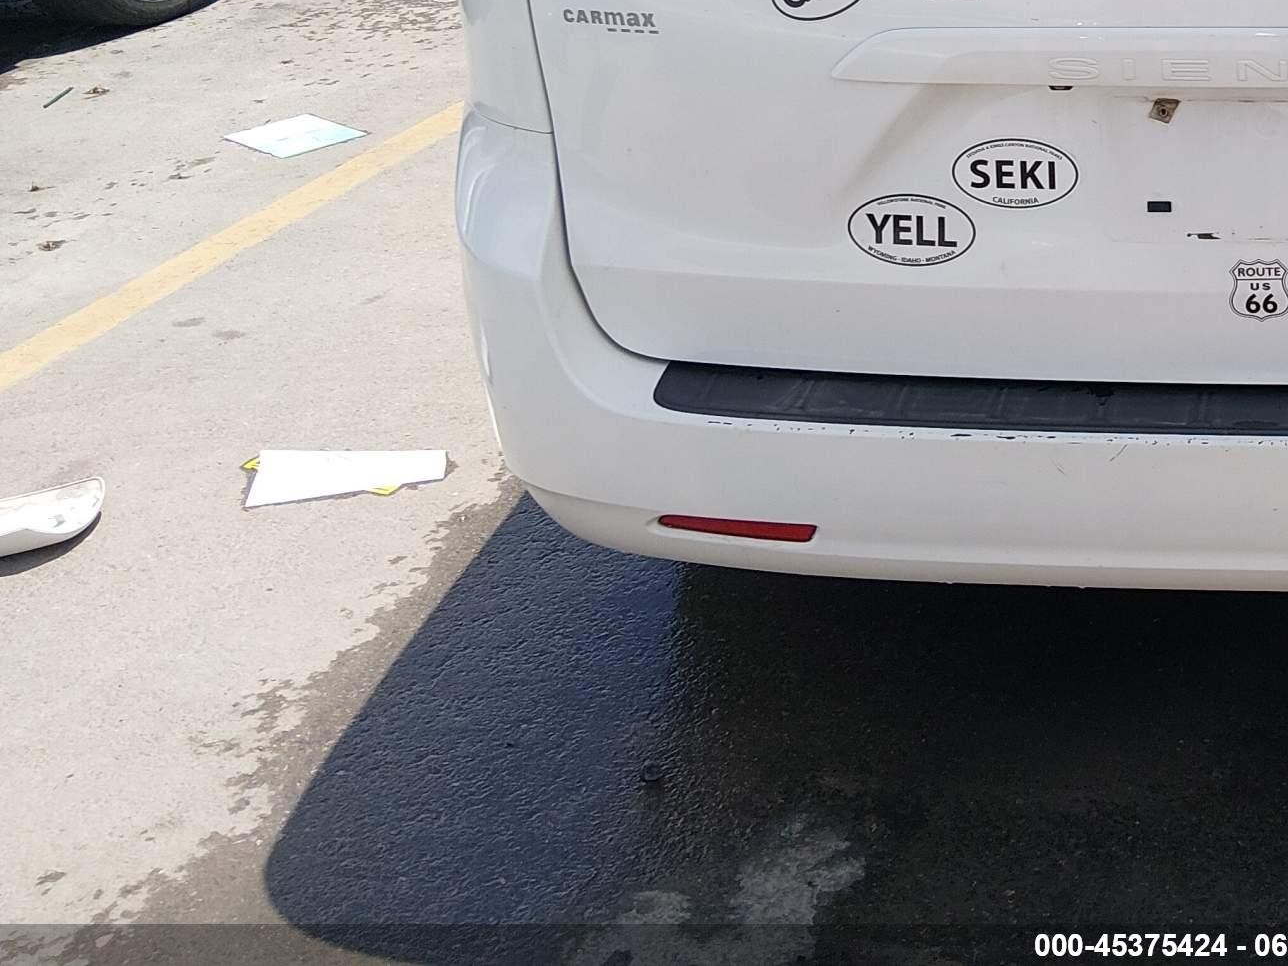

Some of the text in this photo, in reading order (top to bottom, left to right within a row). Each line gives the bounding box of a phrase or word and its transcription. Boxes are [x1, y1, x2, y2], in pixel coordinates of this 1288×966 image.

[970, 159, 1057, 190] SEKI
[992, 196, 1039, 205] CALIFORNIA
[865, 213, 958, 248] YELL
[868, 245, 898, 261] WYOMING
[925, 250, 957, 263] MONTANA
[1238, 267, 1281, 277] ROUTE
[1250, 282, 1271, 291] US
[1246, 293, 1278, 314] 66
